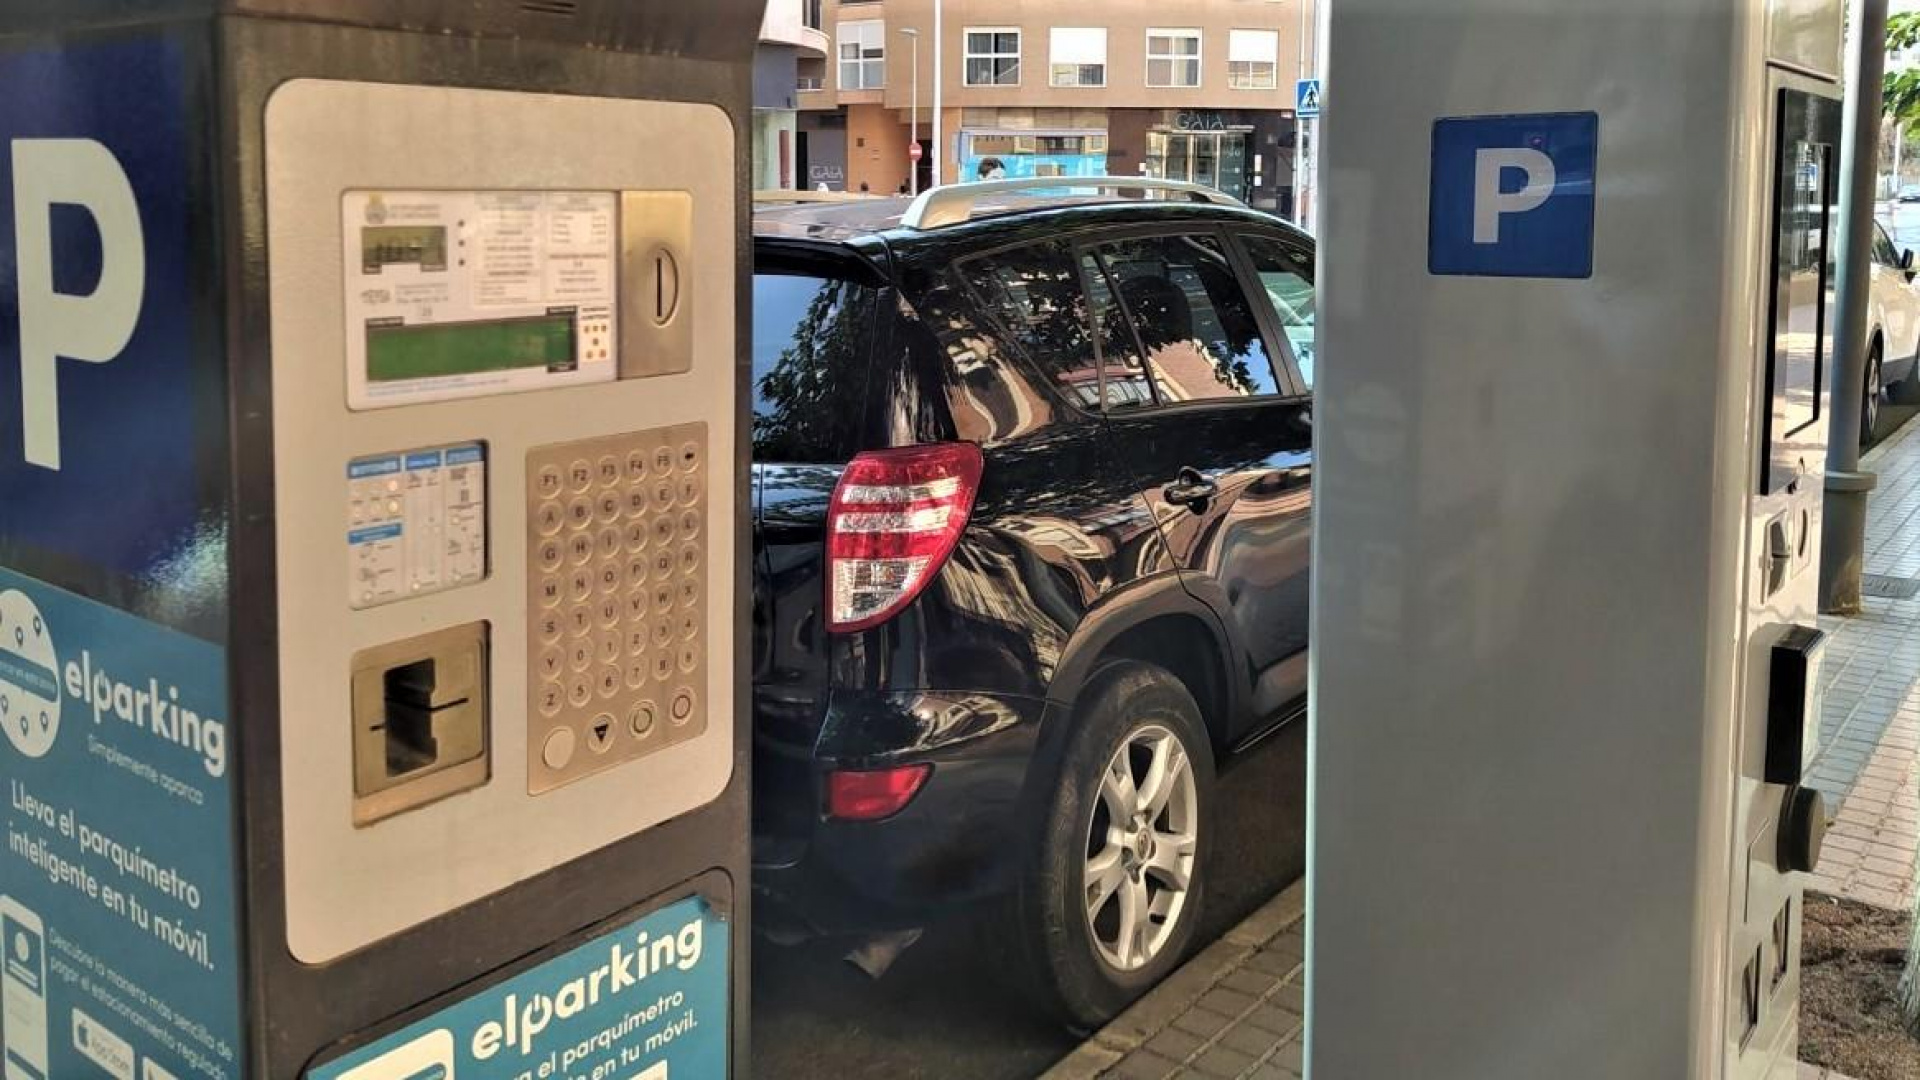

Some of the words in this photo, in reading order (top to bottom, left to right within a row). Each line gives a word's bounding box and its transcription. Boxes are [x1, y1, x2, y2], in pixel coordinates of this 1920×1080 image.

[1473, 148, 1556, 243] P
[11, 138, 145, 471] P
[65, 649, 225, 777] elparking
[11, 778, 55, 828] Lleva
[59, 809, 75, 839] el
[9, 820, 98, 898] inteligente
[102, 885, 125, 916] en
[129, 893, 148, 930] tu
[154, 914, 215, 971] móvil.
[471, 918, 703, 1060] elparking
[592, 1058, 616, 1080] en
[621, 1044, 640, 1066] tu
[646, 1008, 698, 1053] móvil.
[537, 1052, 556, 1079] el
